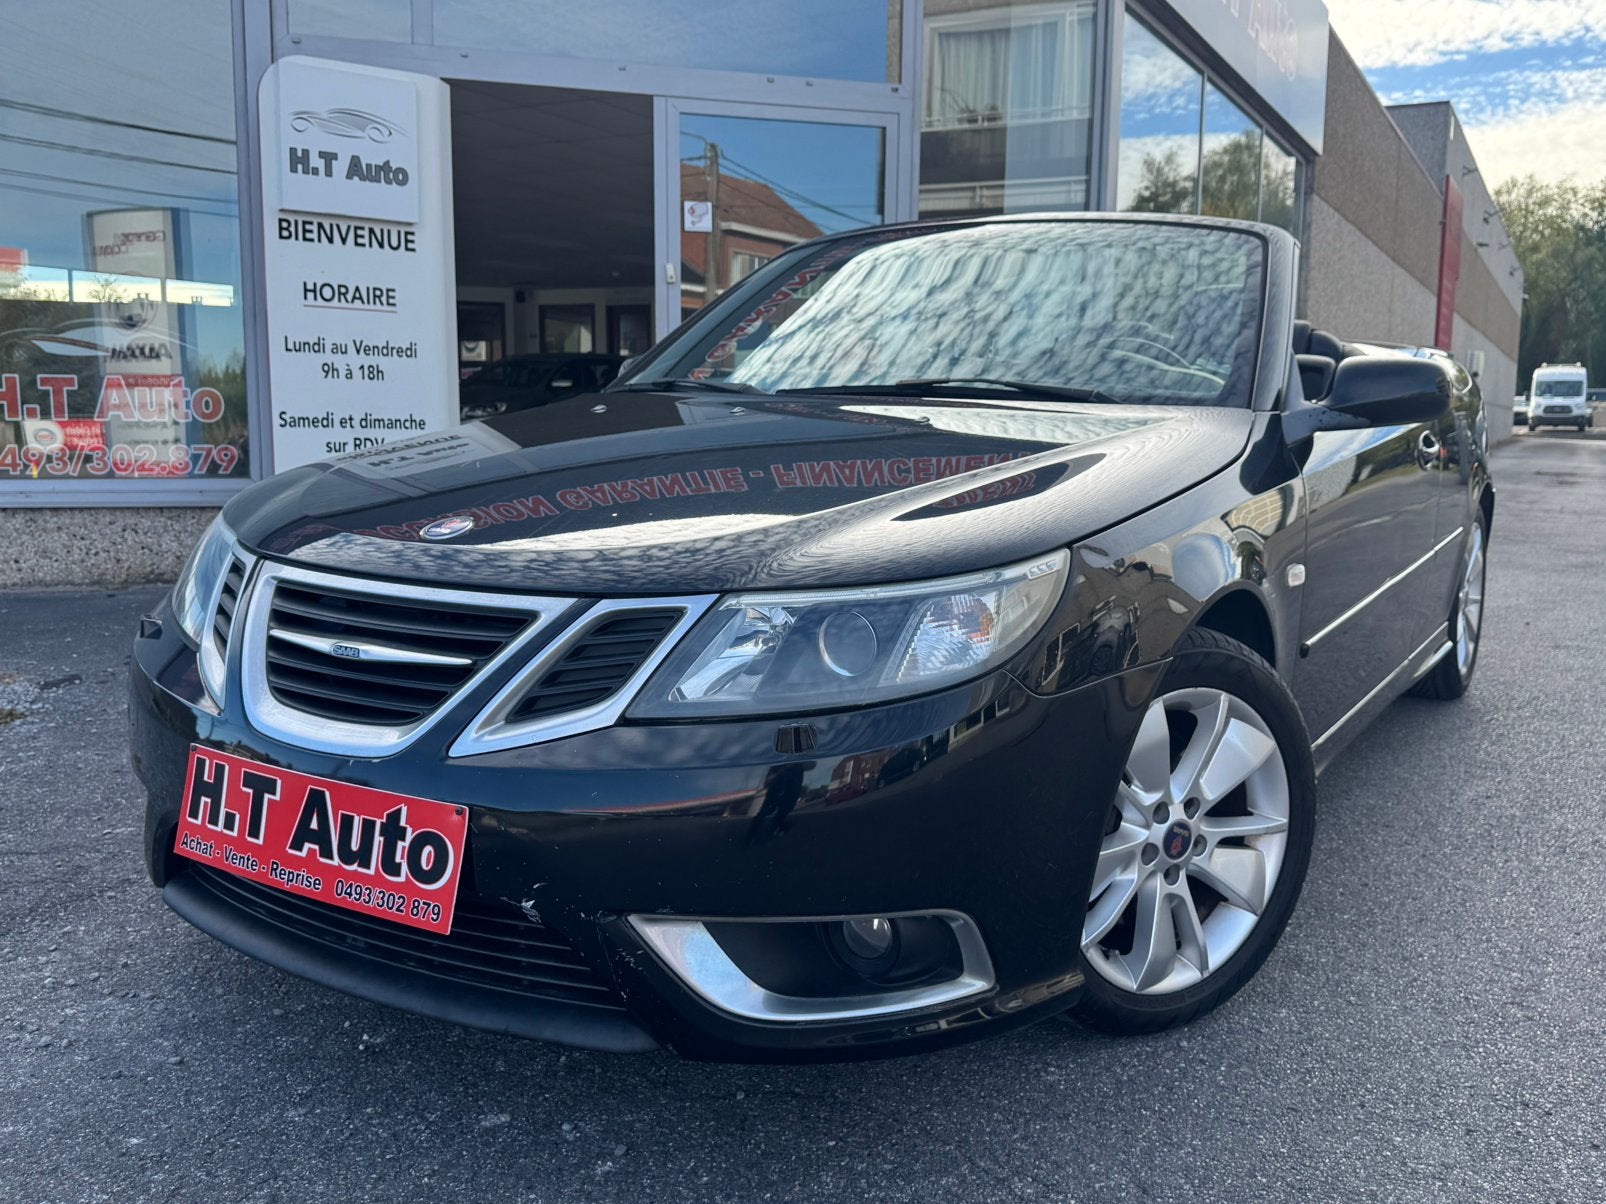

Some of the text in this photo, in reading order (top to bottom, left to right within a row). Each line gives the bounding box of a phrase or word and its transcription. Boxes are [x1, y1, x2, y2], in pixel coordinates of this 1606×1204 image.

[288, 146, 409, 187] H.T Auto
[277, 217, 417, 252] BIENVENUE
[303, 281, 397, 307] HORAIRE
[284, 335, 418, 359] Lundi au Vendredi
[321, 362, 385, 381] 9h à 18h
[94, 375, 225, 423] Auto
[278, 411, 426, 430] Samedi et dimanche
[325, 442, 349, 453] sur
[186, 754, 455, 890] H.T Auto
[180, 831, 215, 857] Achat
[223, 845, 259, 872] Vente
[268, 860, 323, 891] Reprise
[335, 878, 407, 914] 0493/302
[410, 898, 442, 923] 879
